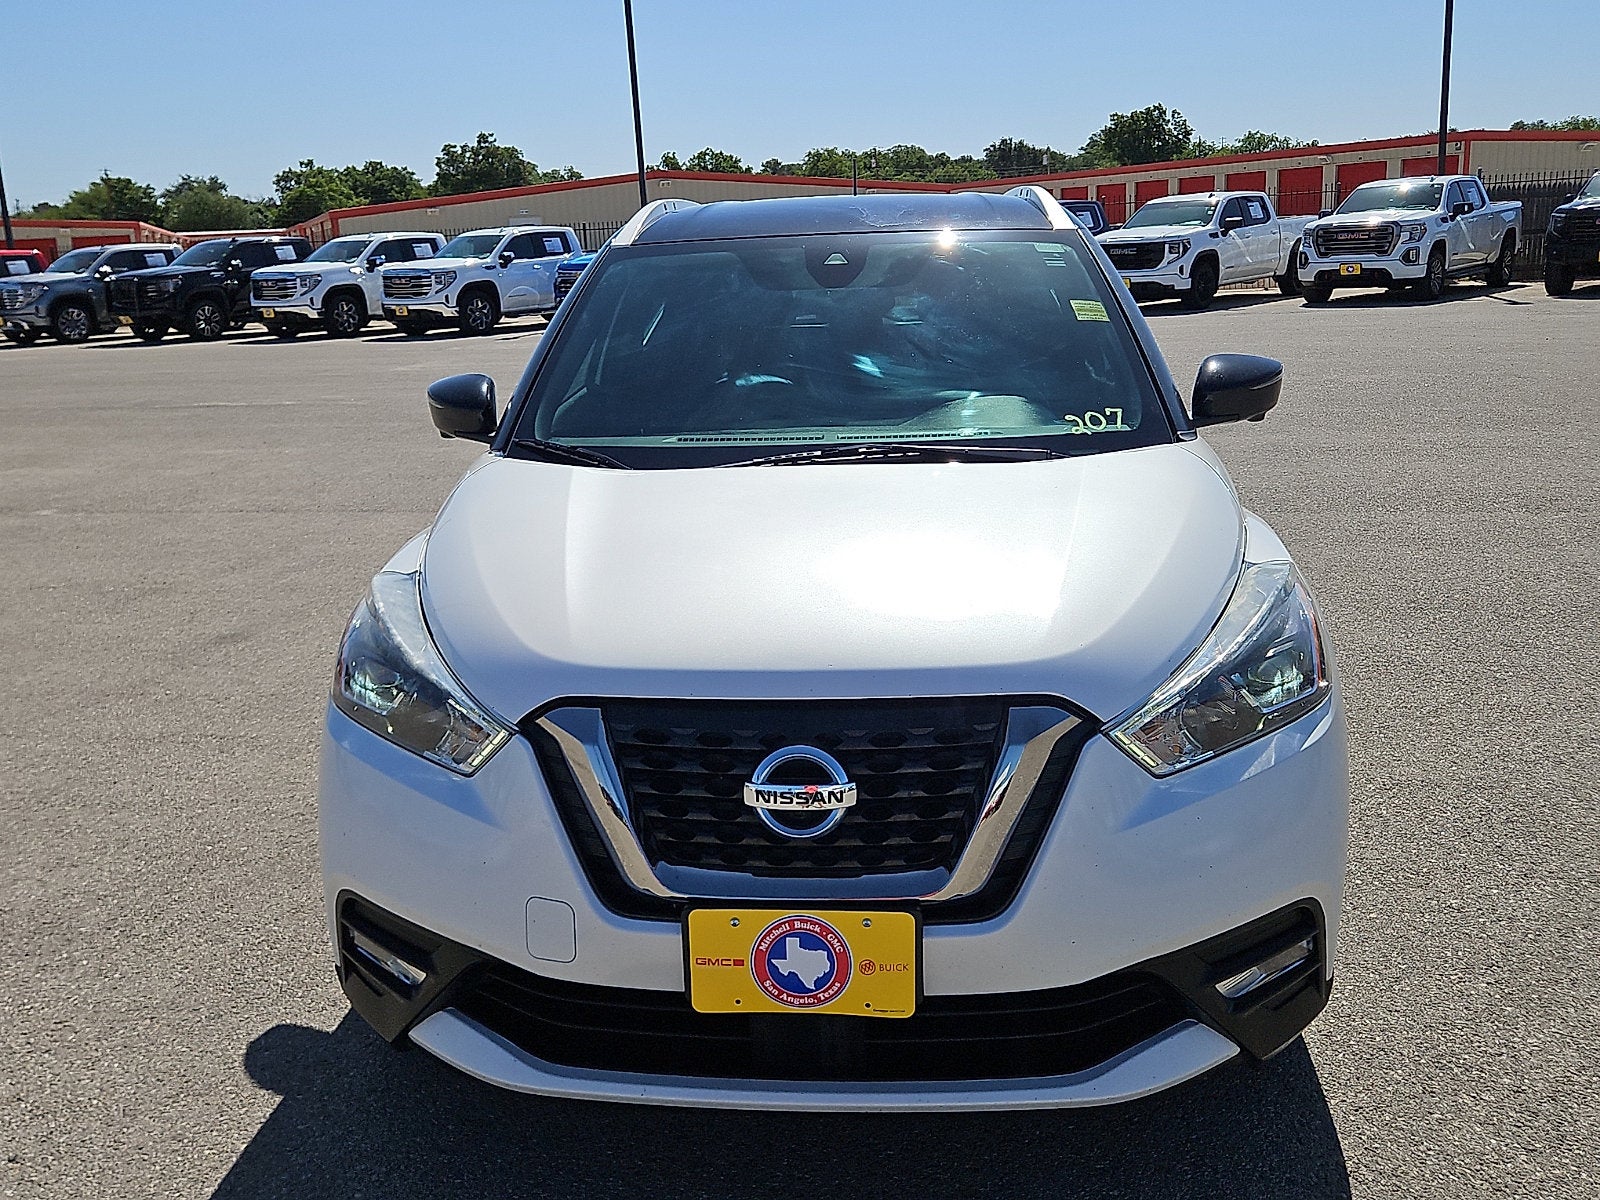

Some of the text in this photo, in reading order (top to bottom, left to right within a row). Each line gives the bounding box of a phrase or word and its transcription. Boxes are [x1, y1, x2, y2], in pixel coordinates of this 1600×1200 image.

[1337, 231, 1369, 239] GMC
[1064, 407, 1124, 436] 207
[754, 789, 845, 805] NISSAN
[759, 920, 844, 954] Mitchell Buick GMC
[695, 957, 733, 967] GMC
[879, 963, 909, 972] BUICK
[763, 979, 842, 1005] San Angelo, Texas
